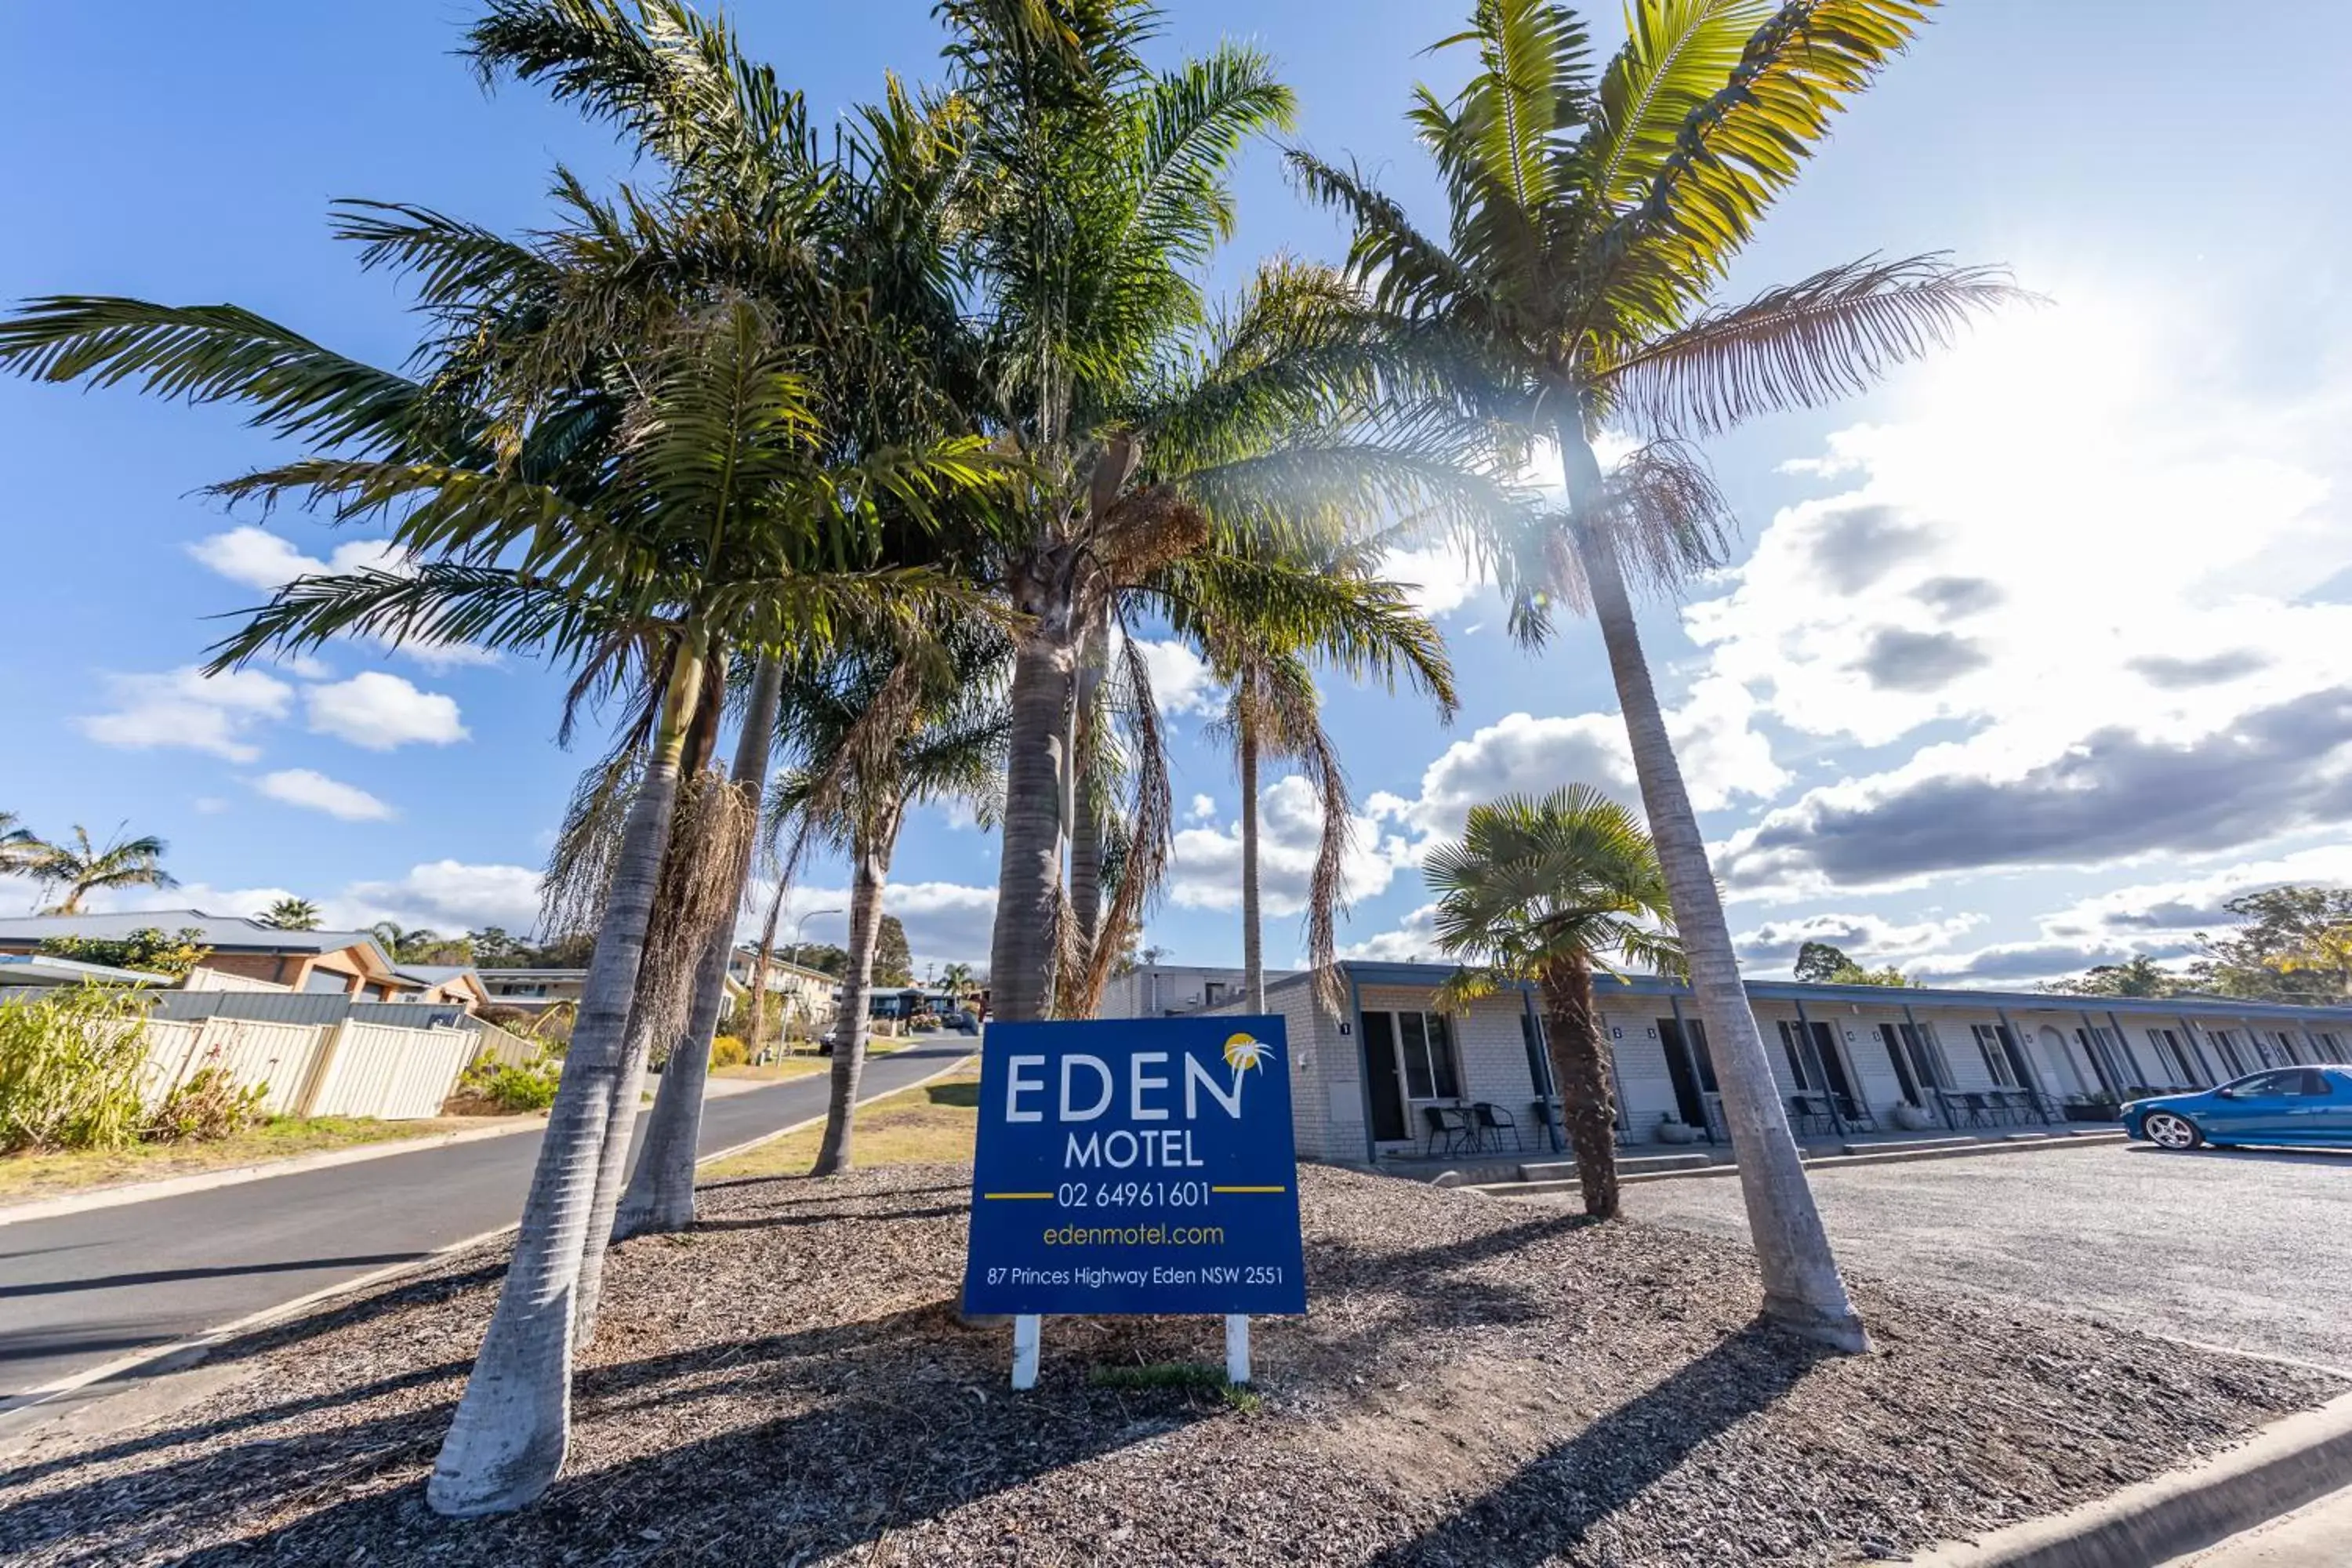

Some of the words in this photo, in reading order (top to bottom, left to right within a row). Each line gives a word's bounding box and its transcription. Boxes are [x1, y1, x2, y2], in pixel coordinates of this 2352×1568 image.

[1006, 1049, 1250, 1122] EDEN
[1064, 1130, 1203, 1168] MOTEL
[1058, 1183, 1087, 1207] 02
[1096, 1182, 1209, 1207] 64961601
[1044, 1223, 1224, 1245] edenmotel.com
[987, 1268, 1007, 1285] 87
[1011, 1268, 1069, 1285] Princes
[1075, 1267, 1148, 1288] Highway
[1153, 1266, 1196, 1284] Eden
[1201, 1266, 1240, 1284] NSW
[1245, 1266, 1283, 1284] 2551
